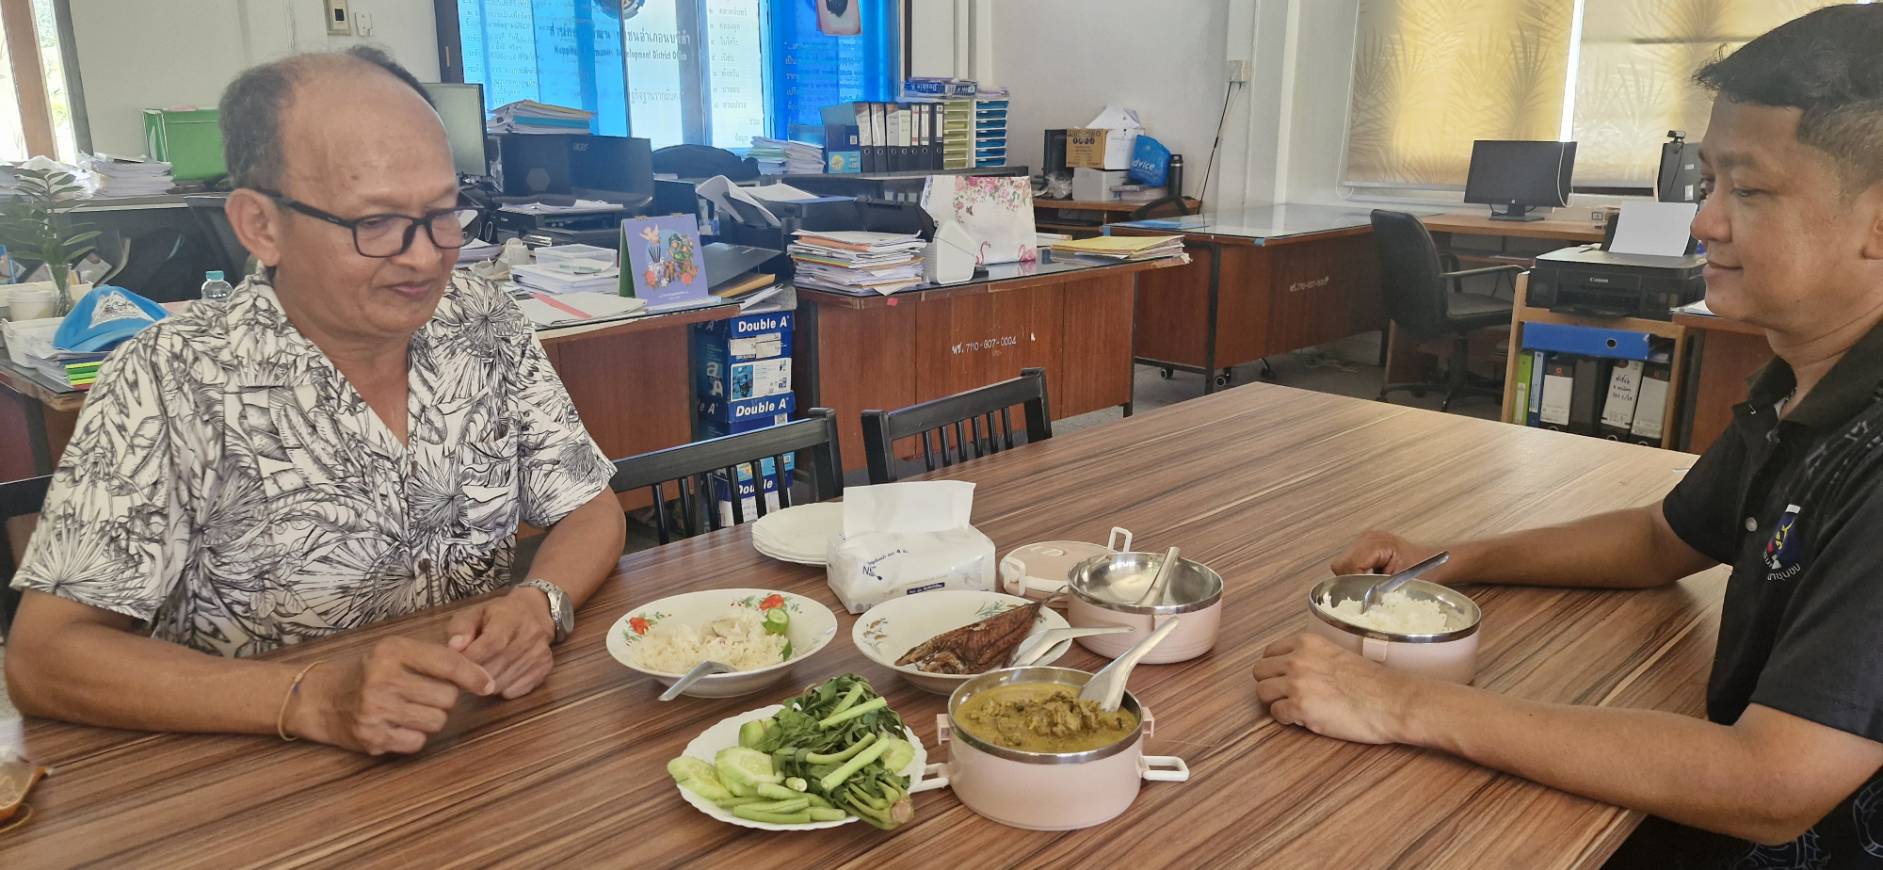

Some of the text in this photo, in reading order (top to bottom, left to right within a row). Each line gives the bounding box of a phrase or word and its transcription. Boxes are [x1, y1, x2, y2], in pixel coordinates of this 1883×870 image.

[1131, 159, 1155, 170] dvice
[738, 315, 788, 333] Double A
[736, 398, 787, 416] Double A
[738, 478, 773, 495] Doule
